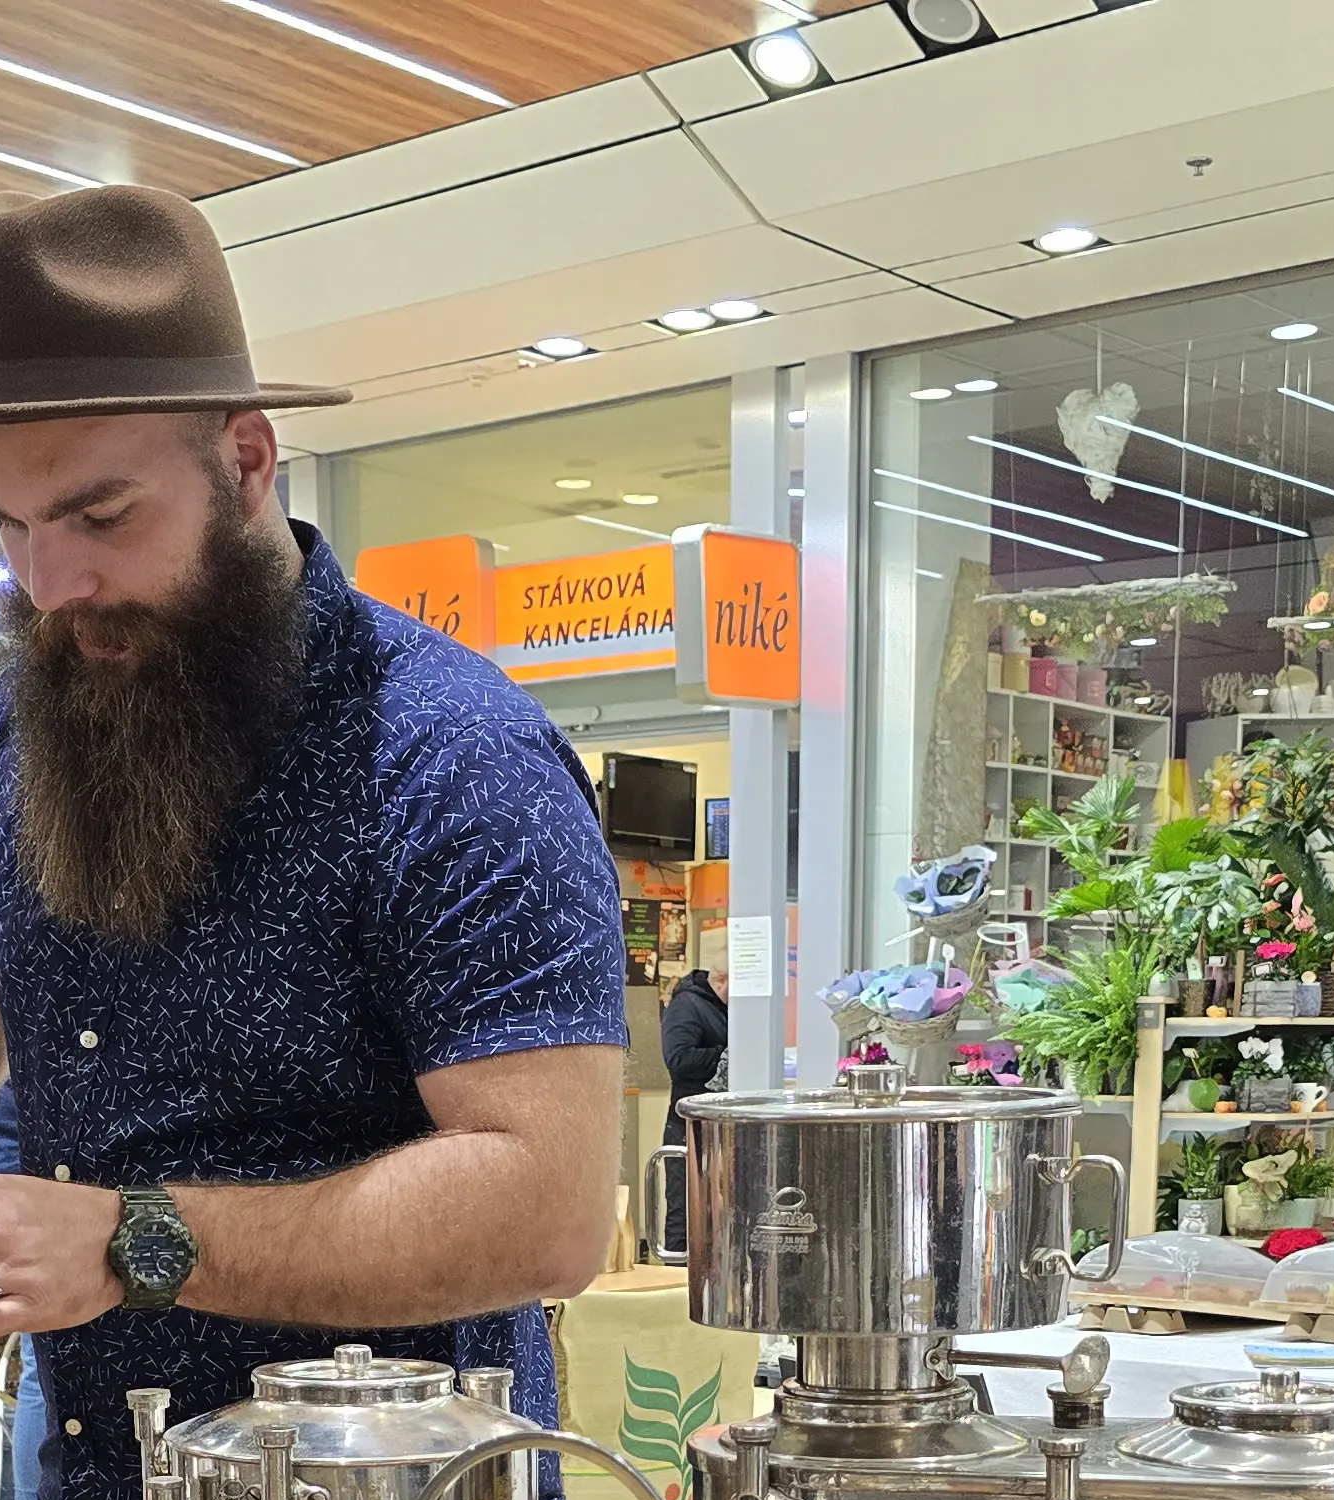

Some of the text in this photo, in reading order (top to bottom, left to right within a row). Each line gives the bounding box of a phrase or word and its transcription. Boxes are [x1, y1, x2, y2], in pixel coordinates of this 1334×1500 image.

[522, 564, 646, 610] STÁVKOVÁ
[522, 607, 675, 650] KANCELÁRIA
[714, 579, 789, 653] niké
